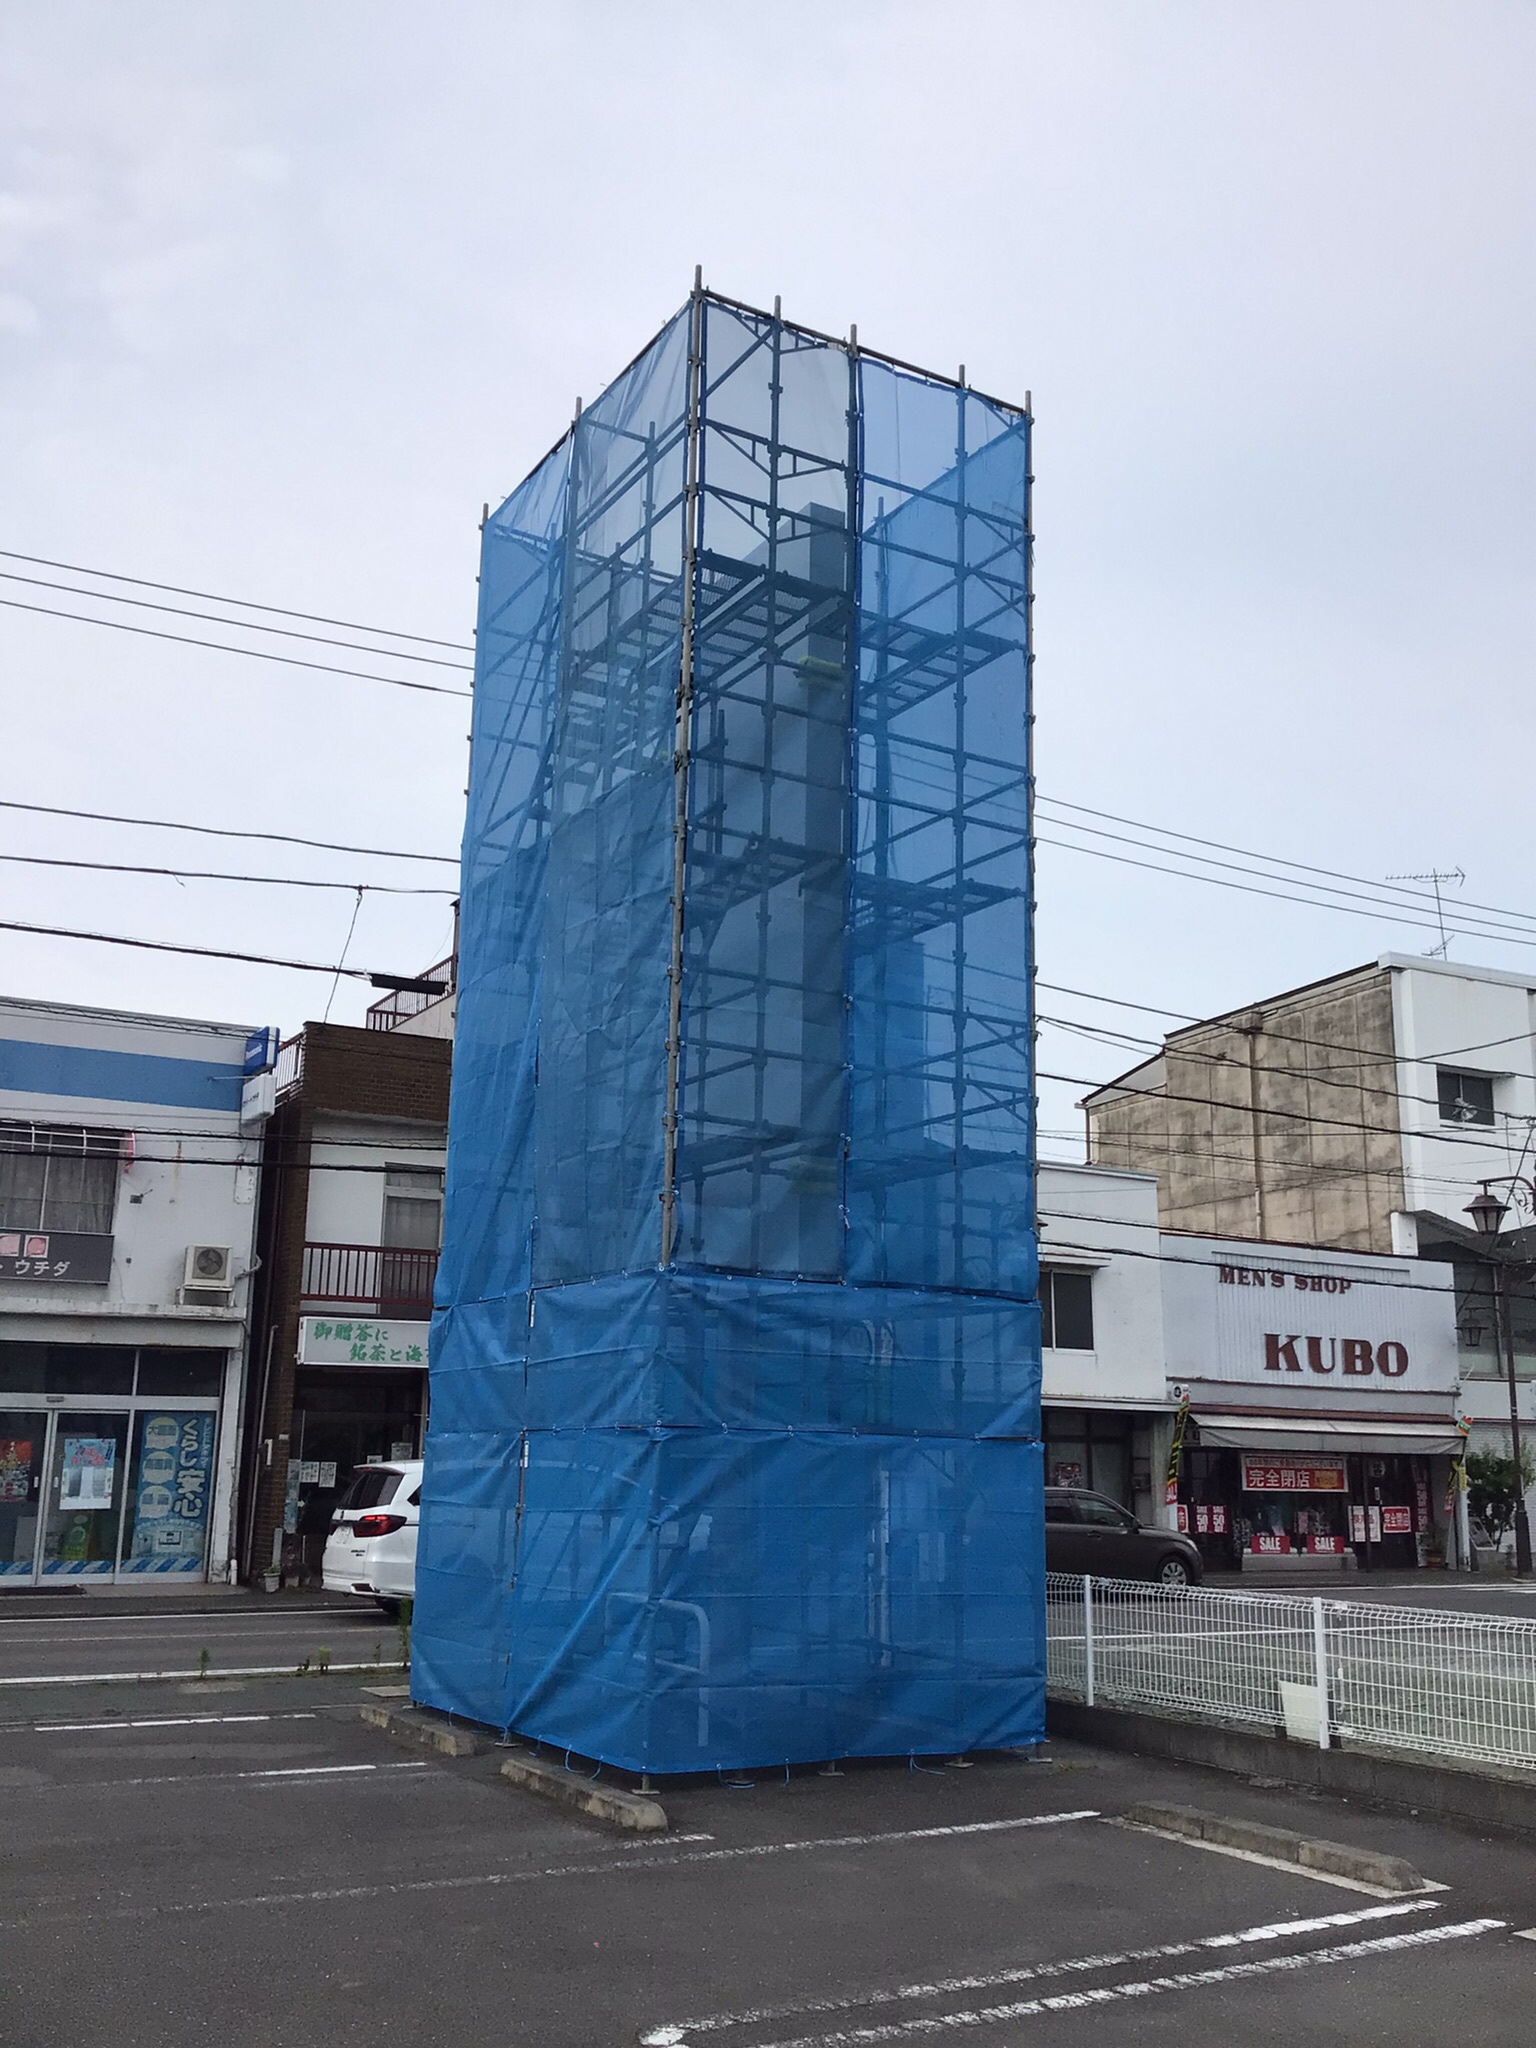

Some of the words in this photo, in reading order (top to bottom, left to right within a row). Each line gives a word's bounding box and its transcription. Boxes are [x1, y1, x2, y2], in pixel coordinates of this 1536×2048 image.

[15, 1260, 70, 1277] ウチダ
[1219, 1266, 1285, 1288] MEN'S
[1294, 1275, 1352, 1294] SHOP
[350, 1343, 429, 1362] 銘茶と海
[1264, 1332, 1409, 1377] KUBO
[1249, 1468, 1310, 1488] 完全閉店
[1259, 1536, 1281, 1551] SALE
[1314, 1536, 1335, 1551] SALE
